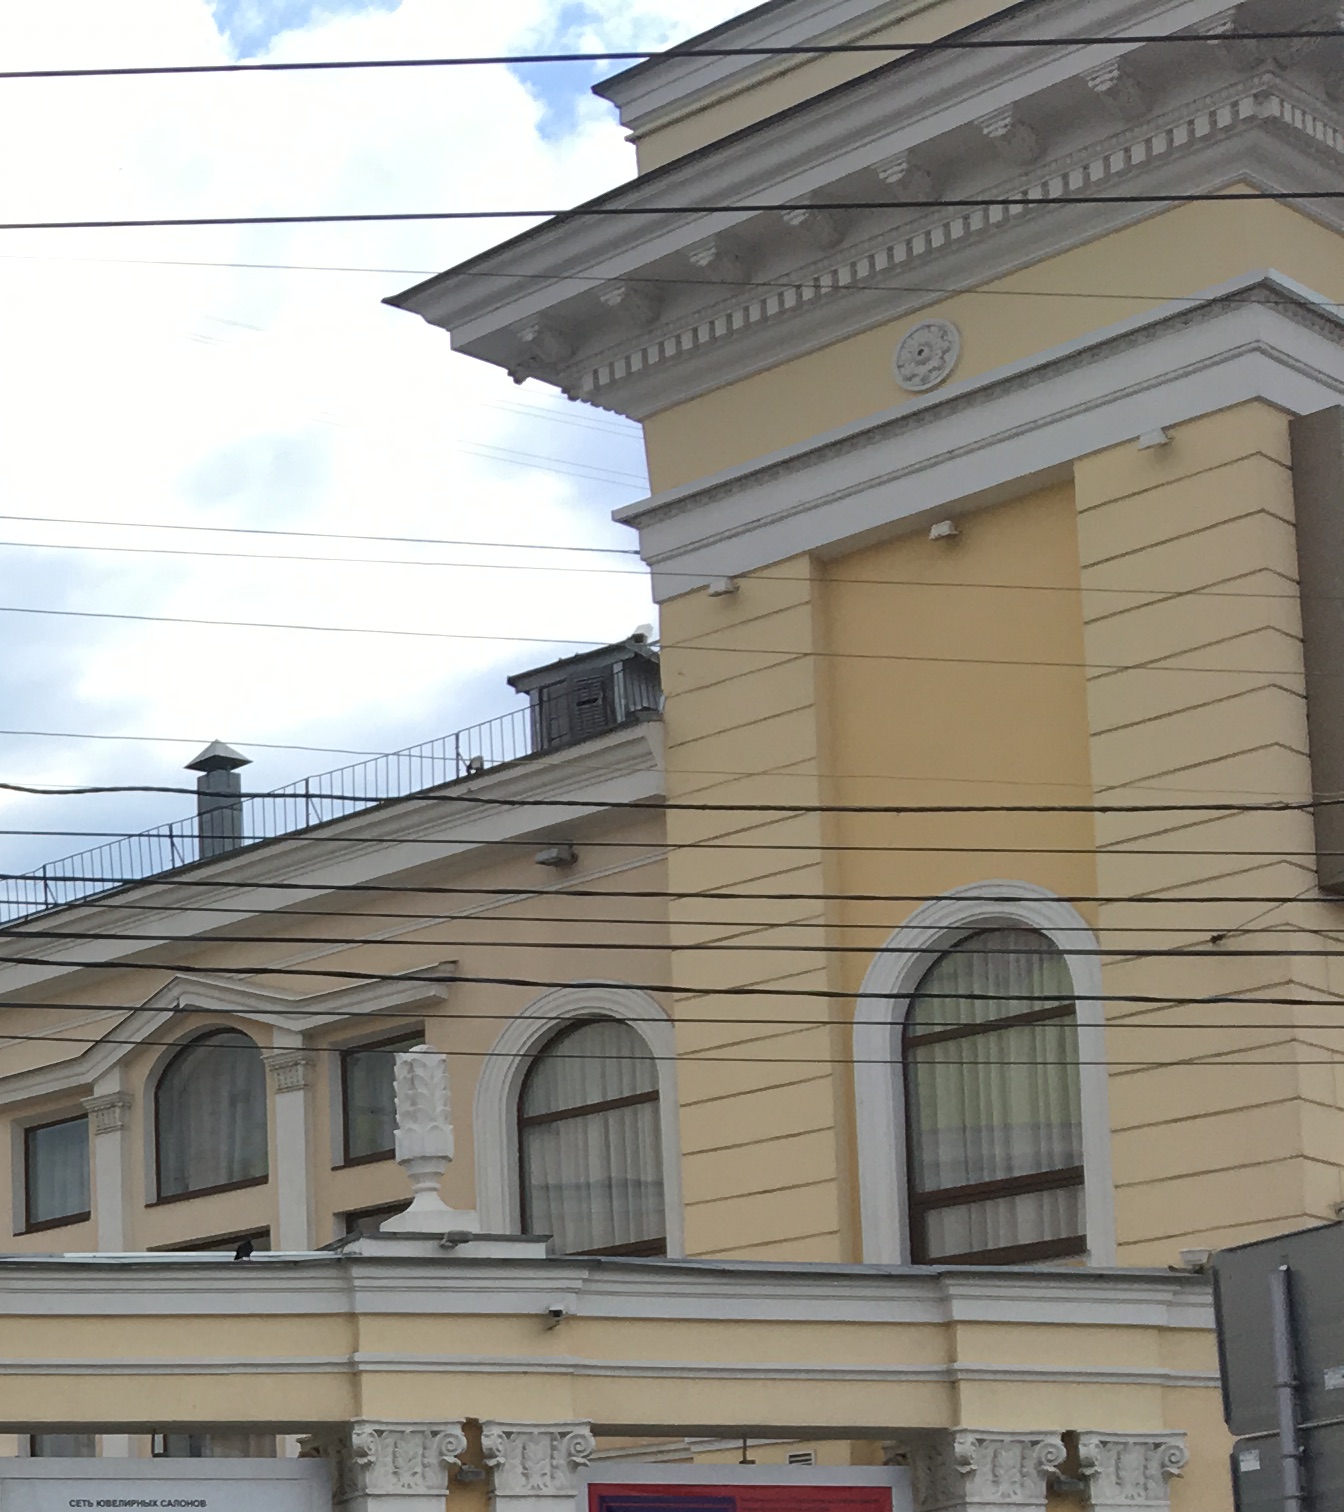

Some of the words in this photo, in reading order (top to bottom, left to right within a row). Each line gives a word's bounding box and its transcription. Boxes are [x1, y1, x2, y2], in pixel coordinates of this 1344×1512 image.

[69, 1499, 94, 1508] СЕТЬ
[96, 1499, 159, 1508] ЮВЕЛИРНЫХ
[160, 1499, 207, 1508] САЛОНОВ
